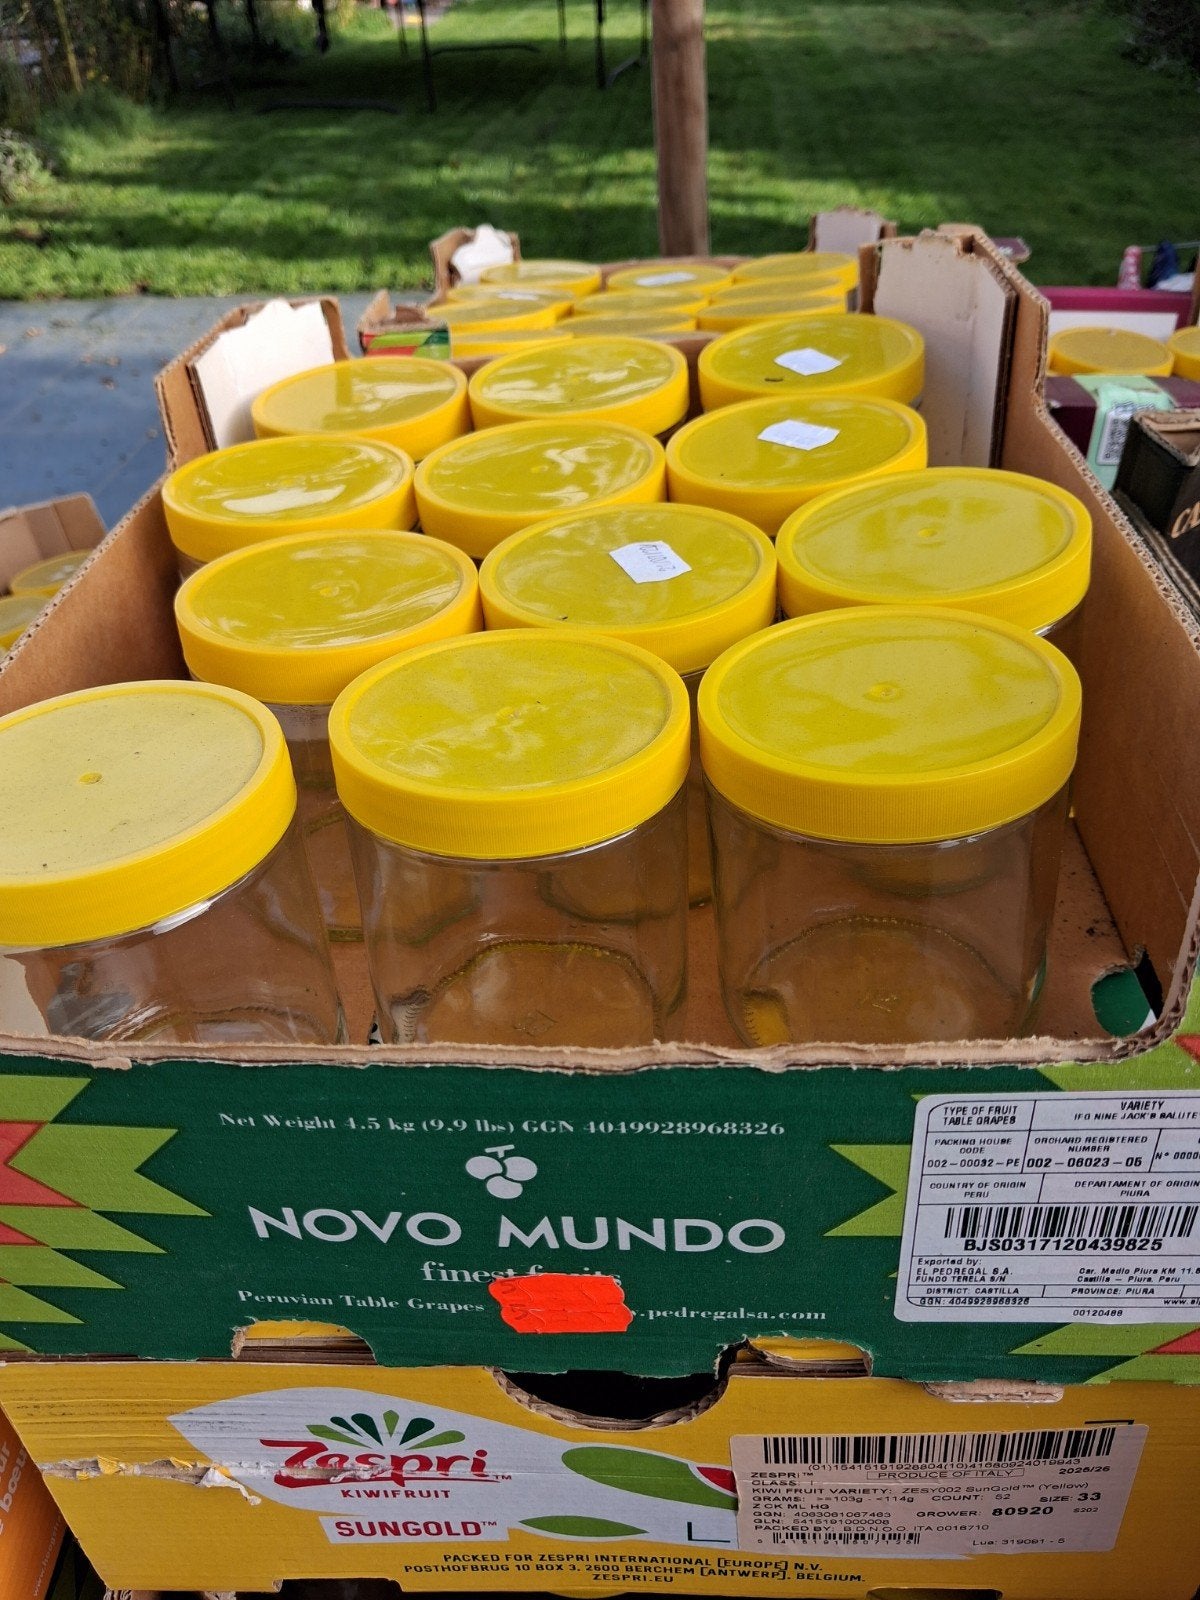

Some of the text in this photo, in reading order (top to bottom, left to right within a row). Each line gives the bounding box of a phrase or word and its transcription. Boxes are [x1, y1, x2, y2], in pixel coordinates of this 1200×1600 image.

[943, 1105, 1018, 1116] TYPE OF FRUIT
[1120, 1100, 1165, 1111] VARIETY
[943, 1116, 1016, 1126] TABLE GRAPES
[1094, 1112, 1117, 1120] NINE
[219, 1112, 255, 1128] Net
[262, 1114, 336, 1132] Weight
[344, 1117, 380, 1131] 4.5
[387, 1117, 415, 1132] kg
[474, 1118, 515, 1133] lbs)
[522, 1119, 575, 1134] GGN
[582, 1120, 786, 1136] 4049928968326
[934, 1138, 976, 1146] PACKING
[1034, 1136, 1148, 1144] ORCHARD REGISTERED
[993, 1181, 1026, 1189] ORIGIN
[1074, 1180, 1146, 1188] DEPARTAMENT
[1166, 1180, 1200, 1188] ORIGIN
[248, 1204, 786, 1254] NOVO MUNDO
[963, 1238, 1163, 1252] BJS0317120439825
[918, 1257, 982, 1267] Exported by:
[916, 1268, 928, 1276] EL
[932, 1267, 988, 1276] PEDREGAL
[1101, 1267, 1130, 1275] Medio
[1134, 1267, 1159, 1275] Piura
[1161, 1267, 1177, 1275] KM
[915, 1275, 947, 1283] FUNDO
[952, 1275, 987, 1283] TERELA
[1077, 1275, 1111, 1283] Castilla
[1158, 1275, 1181, 1283] Peru
[975, 1287, 1020, 1295] CASTILLA
[1070, 1287, 1156, 1295] PROVINCE: PIURA
[237, 1289, 827, 1322] Peruvian Table Grapes .pedregalsa.com
[877, 1471, 947, 1480] PRODUCE
[973, 1469, 1014, 1478] ITALY
[901, 1486, 961, 1494] ZESY002
[1038, 1482, 1089, 1492] (Yellow)
[340, 1489, 451, 1499] KIWIFRUIT
[931, 1494, 984, 1502] COUNT:
[1039, 1495, 1073, 1503] SIZE:
[1077, 1492, 1101, 1501] 33
[991, 1506, 1054, 1517] 80920
[913, 1524, 933, 1532] ITA
[443, 1553, 500, 1563] PACKED
[505, 1553, 533, 1562] FOR
[539, 1554, 590, 1562] ZESPRI
[595, 1554, 712, 1567] INTERNATIONAL
[793, 1562, 823, 1571] N.V.
[404, 1564, 510, 1573] POSTHOFBRUG
[515, 1563, 531, 1571] 10
[535, 1563, 564, 1572] BOX
[585, 1564, 620, 1573] 2600
[624, 1565, 695, 1575] BERCHEM
[796, 1572, 866, 1583] BELGIUM.
[592, 1573, 674, 1583] ZESPRI.EU
